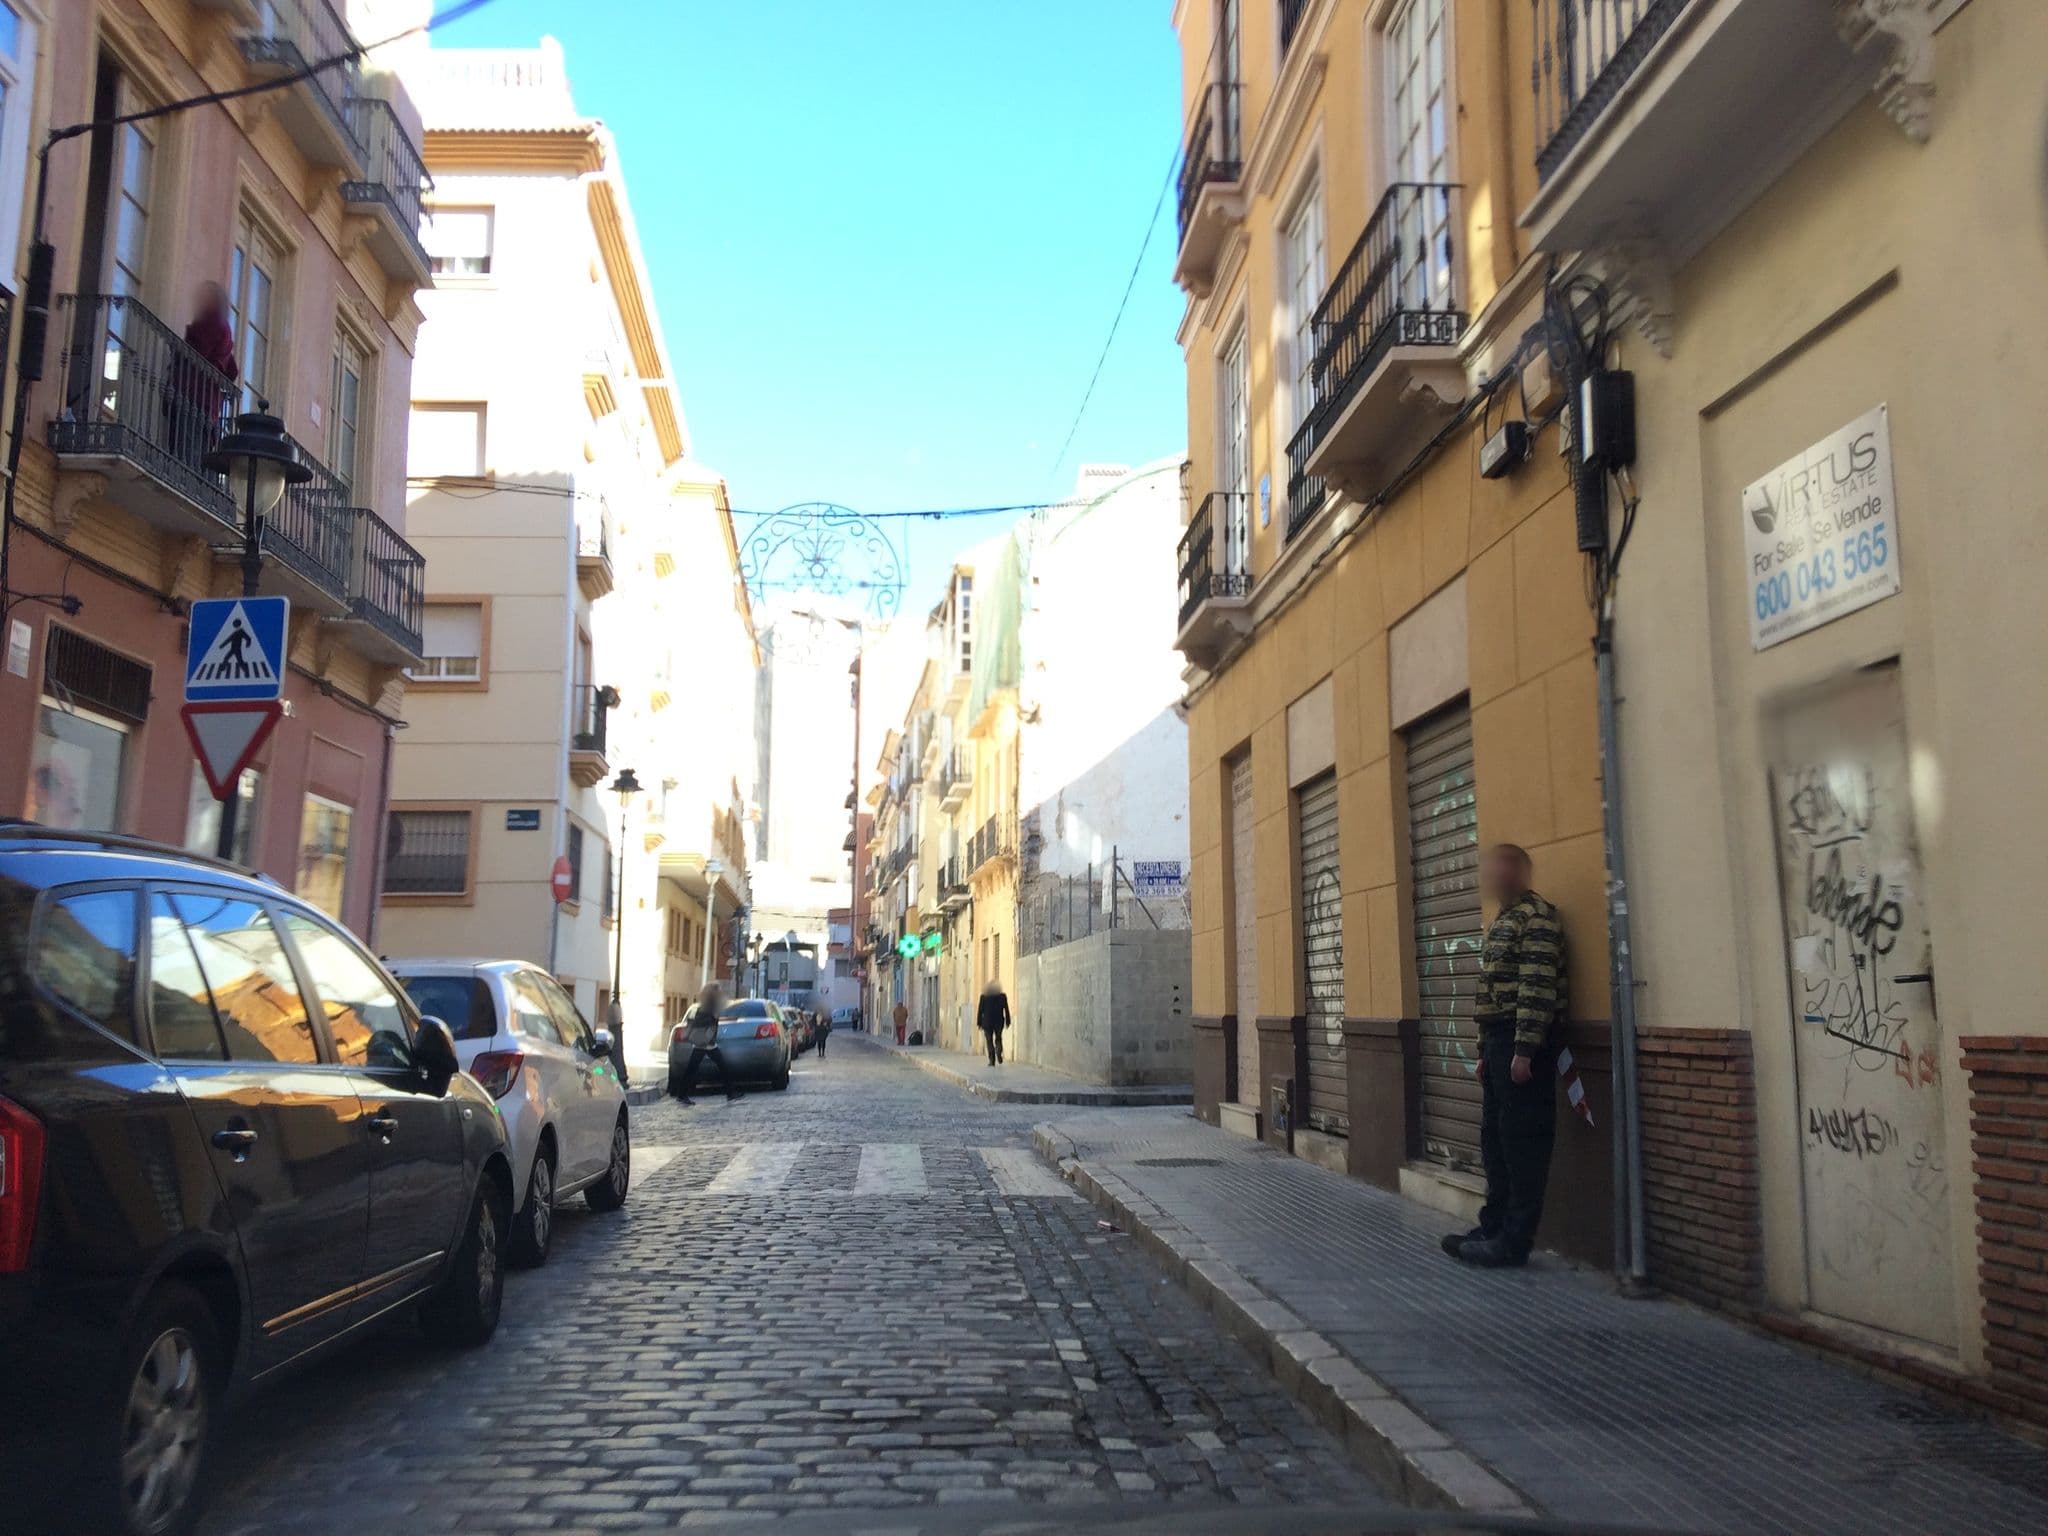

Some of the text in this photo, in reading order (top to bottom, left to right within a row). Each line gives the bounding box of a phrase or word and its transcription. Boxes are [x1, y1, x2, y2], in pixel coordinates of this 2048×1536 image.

[1760, 431, 1877, 525] VIRTUS
[1823, 466, 1878, 509] ESTATE
[1753, 495, 1882, 577] For Sale Se Vende
[1755, 570, 1792, 621] 600
[1797, 548, 1837, 601] 043
[1843, 521, 1888, 581] 565
